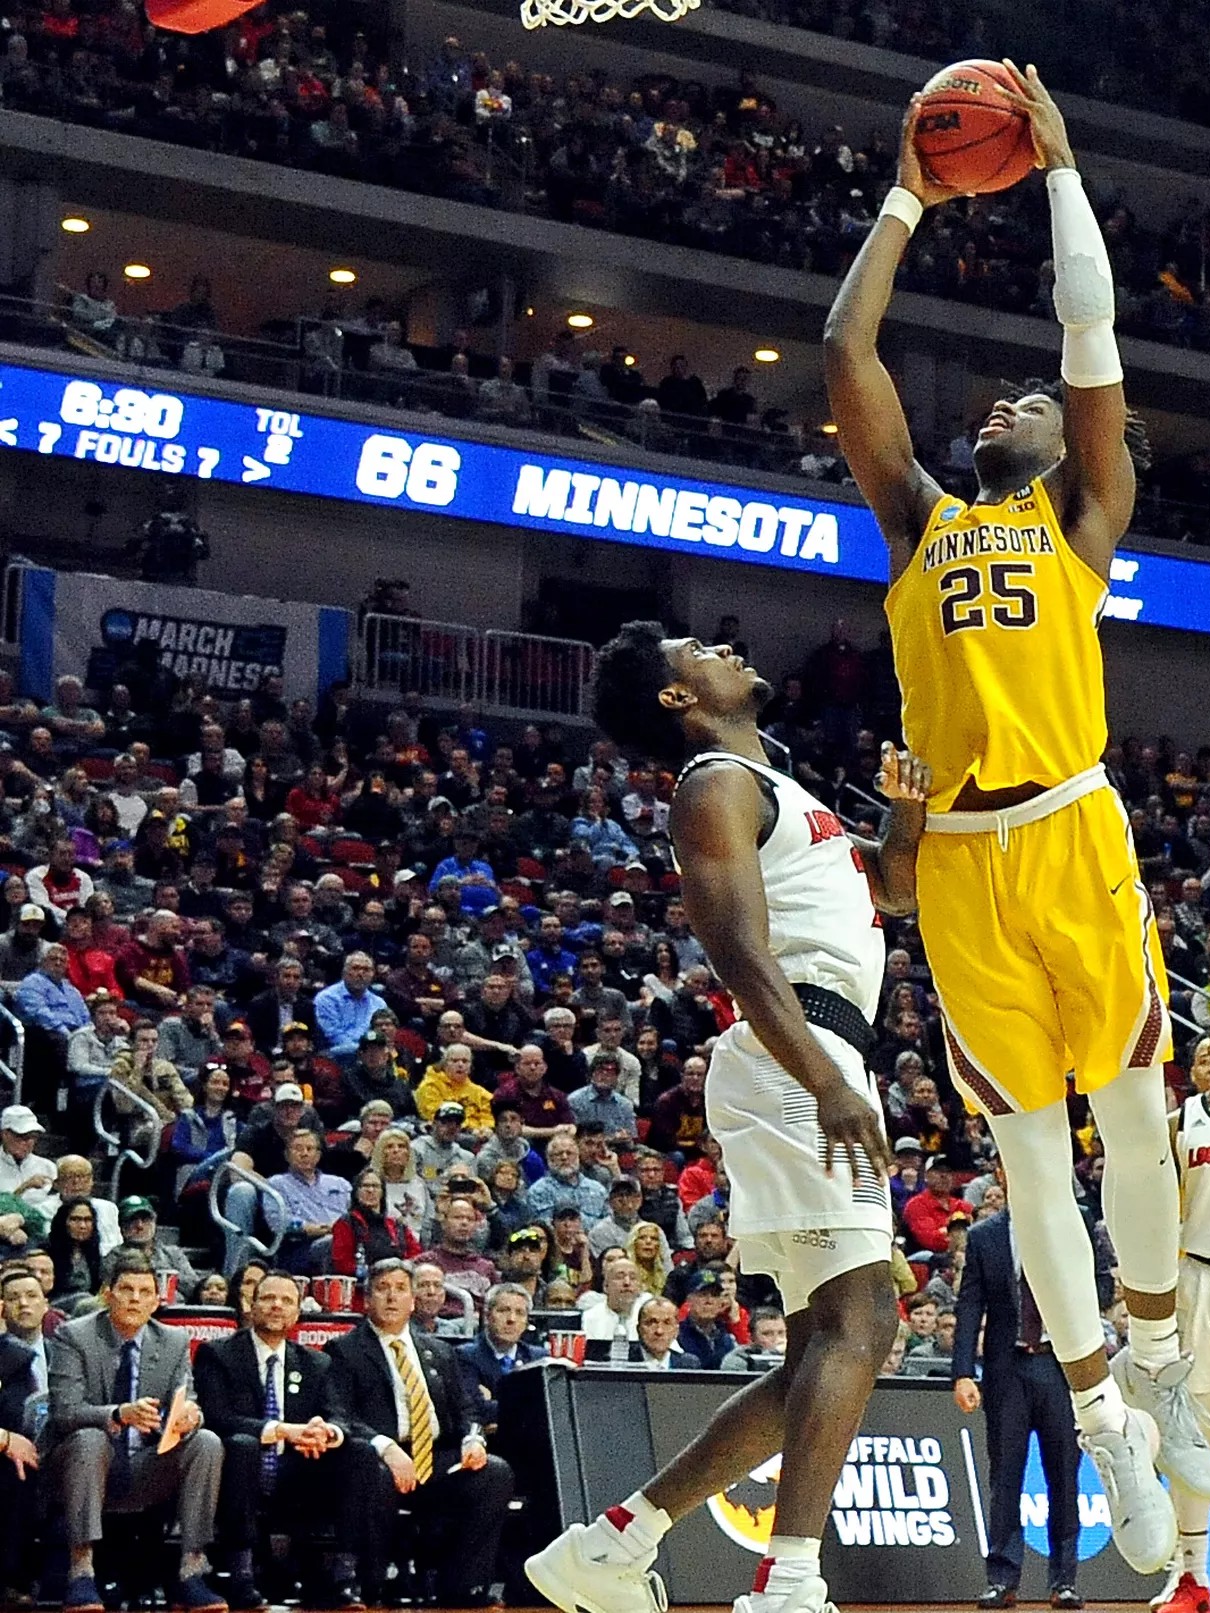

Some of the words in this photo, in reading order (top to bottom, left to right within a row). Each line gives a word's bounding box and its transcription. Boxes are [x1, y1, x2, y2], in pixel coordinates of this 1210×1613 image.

[256, 408, 302, 437] TOL
[38, 421, 62, 453] 7
[75, 430, 185, 473] FOULS
[198, 447, 220, 478] 7
[355, 434, 461, 506] 66
[512, 464, 839, 564] MINNESOTA
[922, 524, 1056, 575] MINNESOTA
[938, 562, 1039, 638] 25
[133, 617, 235, 658] MARCH
[792, 1234, 837, 1250] adidas
[832, 1464, 950, 1510] WILD
[830, 1510, 957, 1546] WINGS
